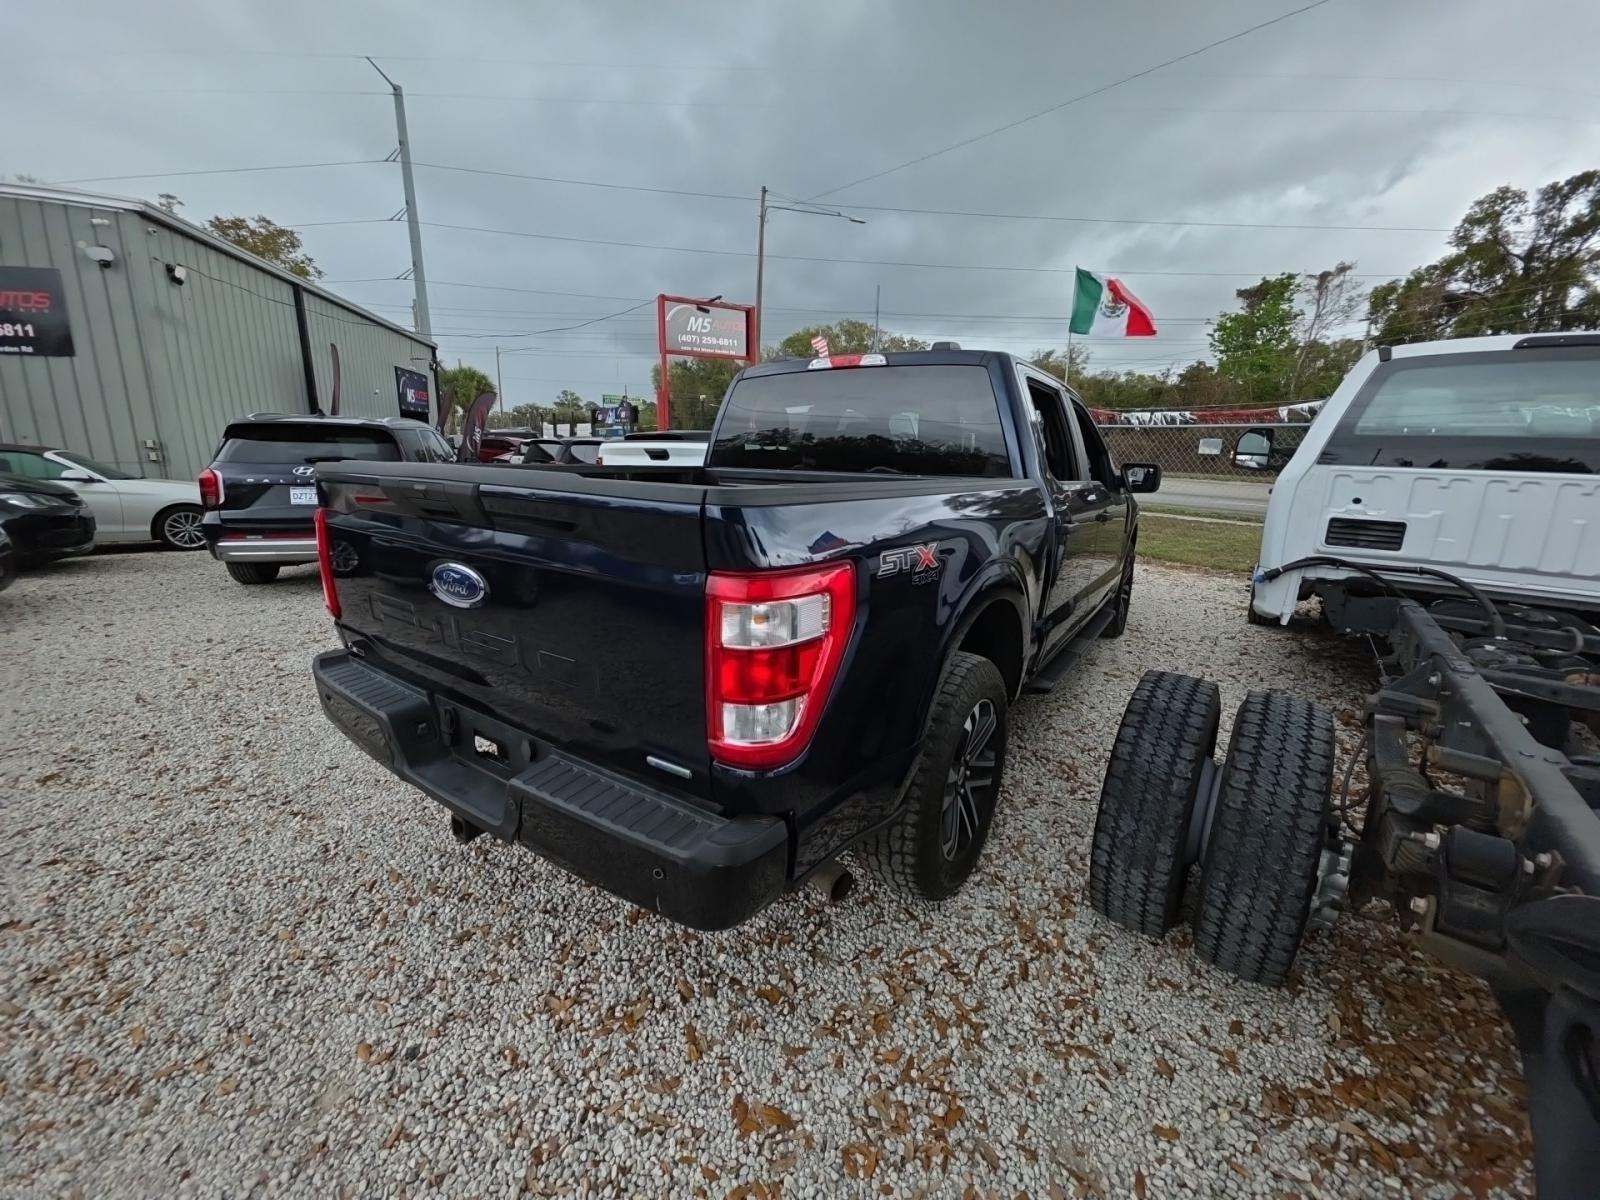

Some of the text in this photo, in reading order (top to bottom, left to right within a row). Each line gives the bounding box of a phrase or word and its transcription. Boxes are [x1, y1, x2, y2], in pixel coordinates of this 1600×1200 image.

[687, 316, 712, 333] M5
[678, 334, 699, 345] (407)
[877, 542, 940, 578] STX
[439, 570, 470, 597] Ford
